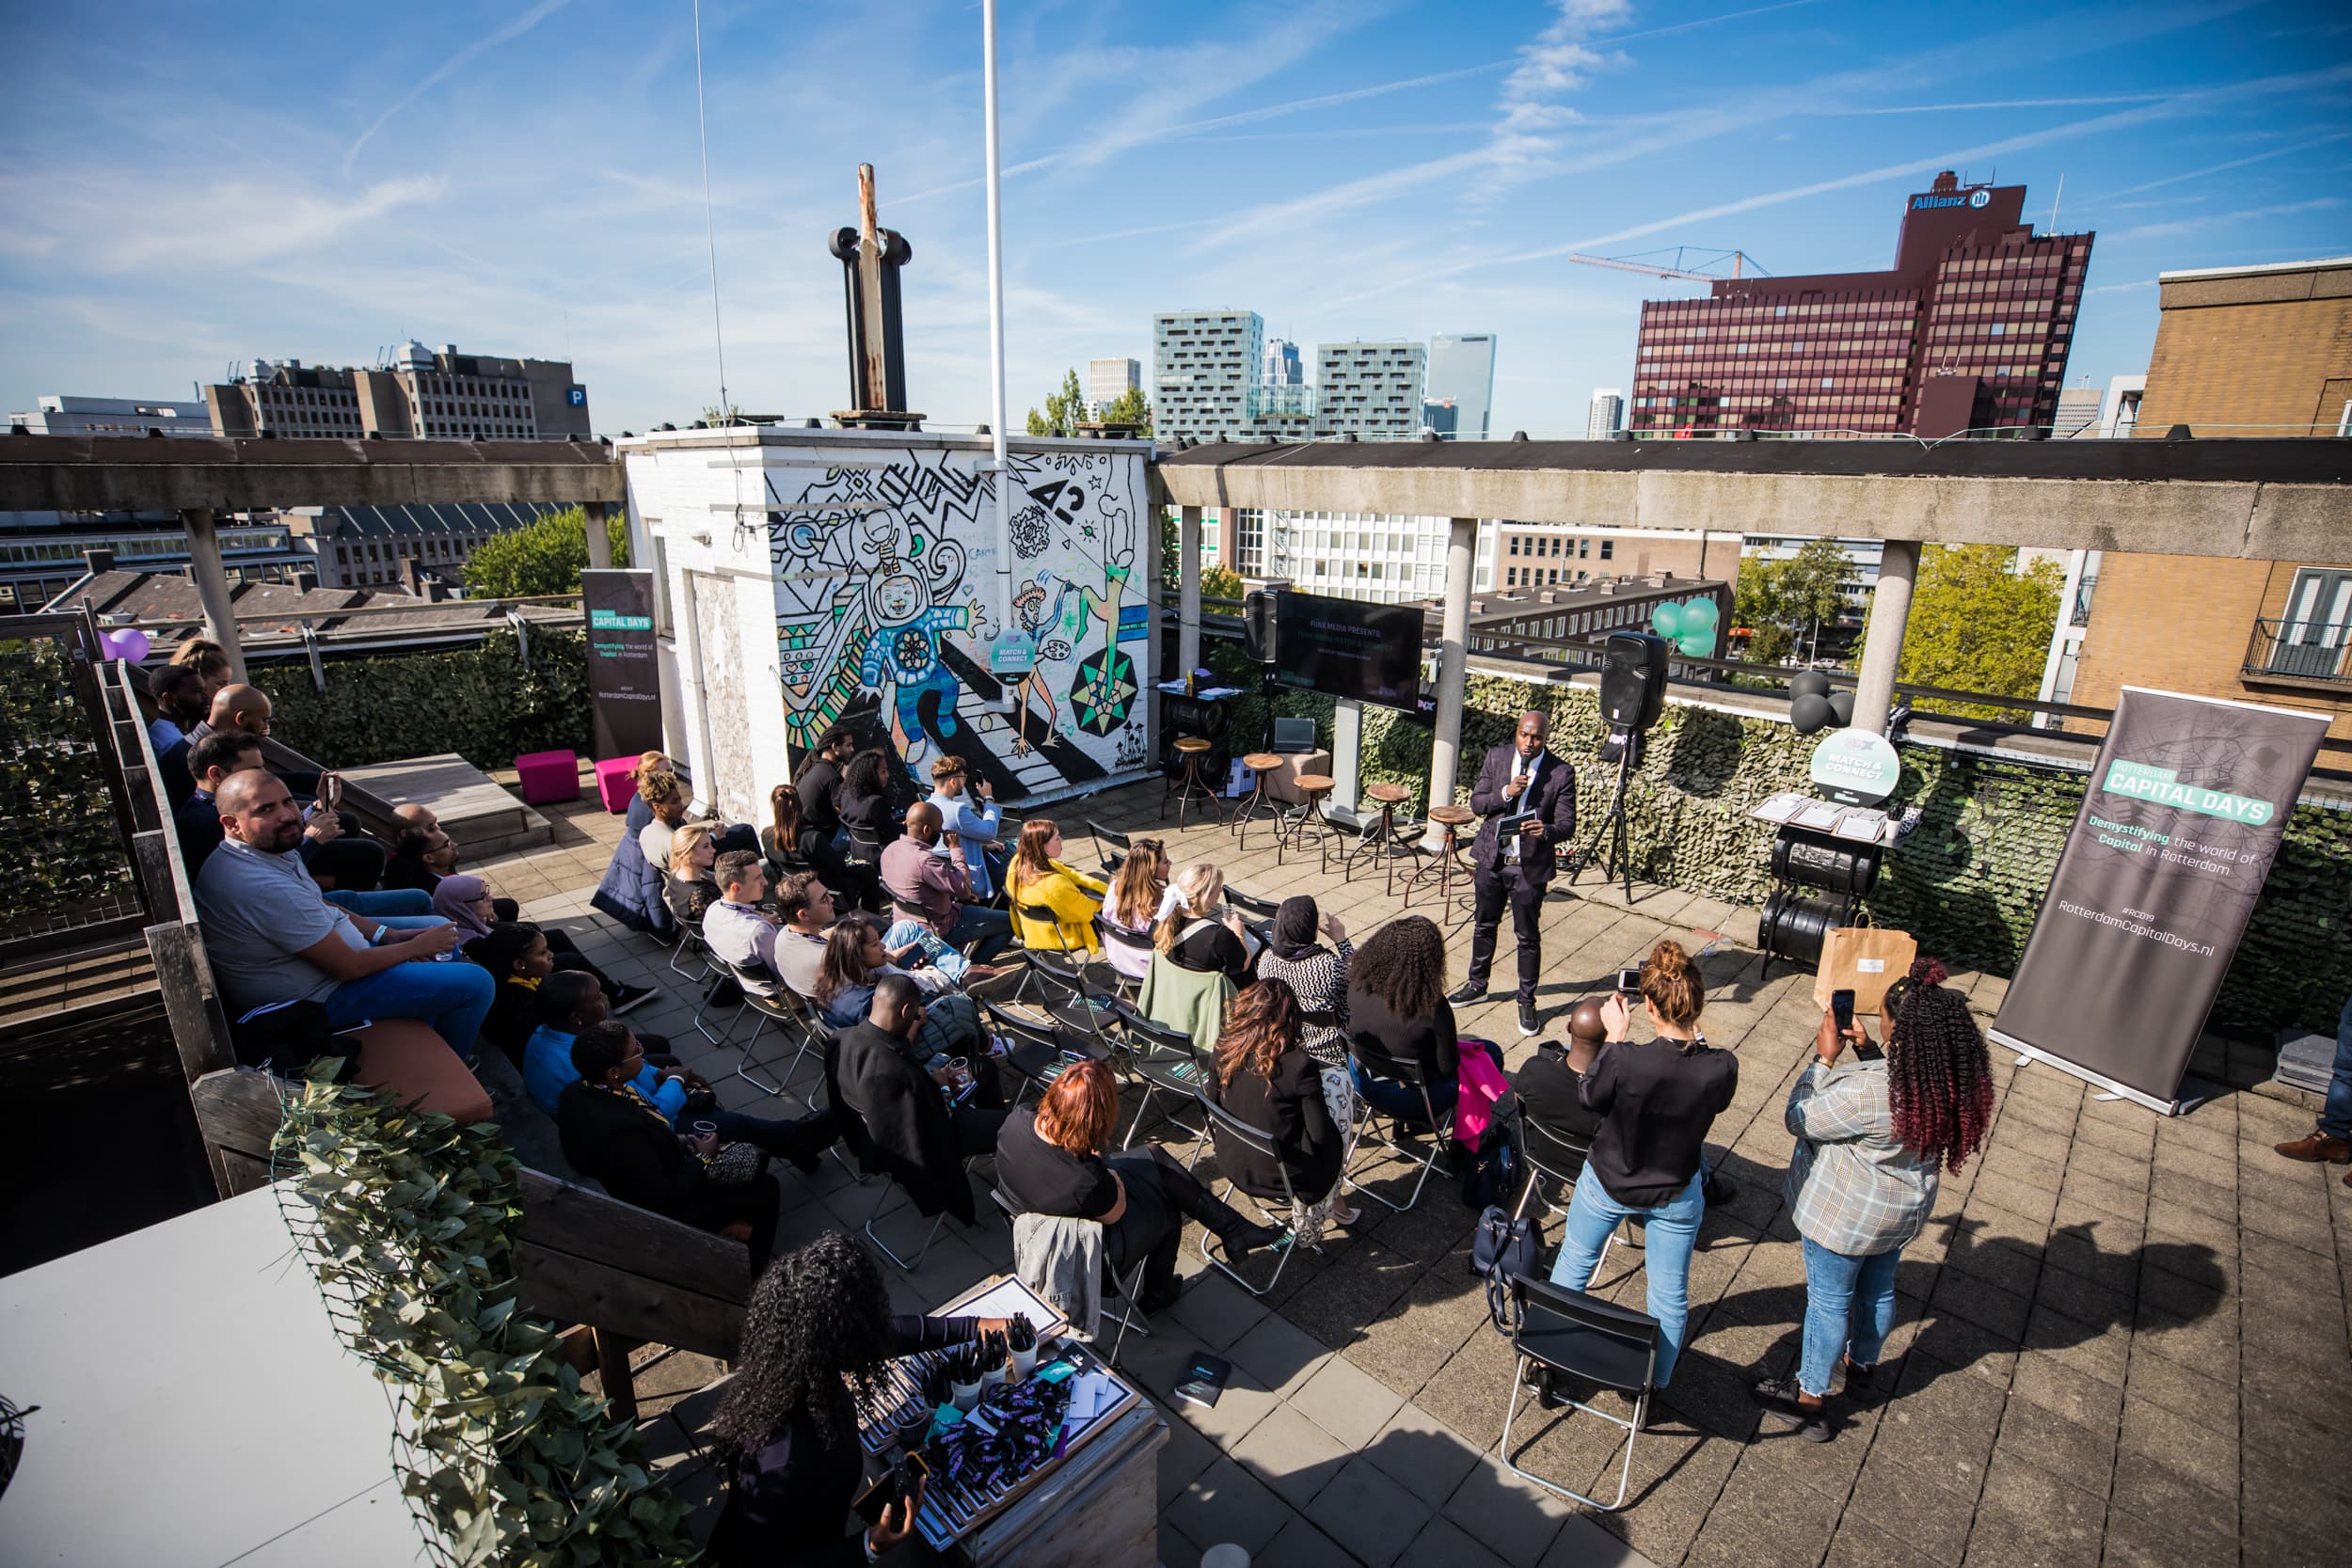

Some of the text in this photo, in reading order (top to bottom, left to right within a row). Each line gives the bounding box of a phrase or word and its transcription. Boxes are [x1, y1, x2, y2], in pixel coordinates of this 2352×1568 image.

[1912, 194, 1966, 210] Allianz
[572, 390, 582, 404] P
[594, 616, 649, 627] CAPITAL DAYS
[1828, 753, 1883, 770] MATCH &
[1825, 763, 1883, 780] CONNECT
[2115, 763, 2173, 781] ROTTERDAM
[2109, 773, 2266, 820] CAPITAL DAYS
[2089, 816, 2256, 865] Demystifying the world of
[2098, 833, 2230, 876] Capital in Rotterdam
[2058, 899, 2216, 958] RotterdamCapitalDays.nl
